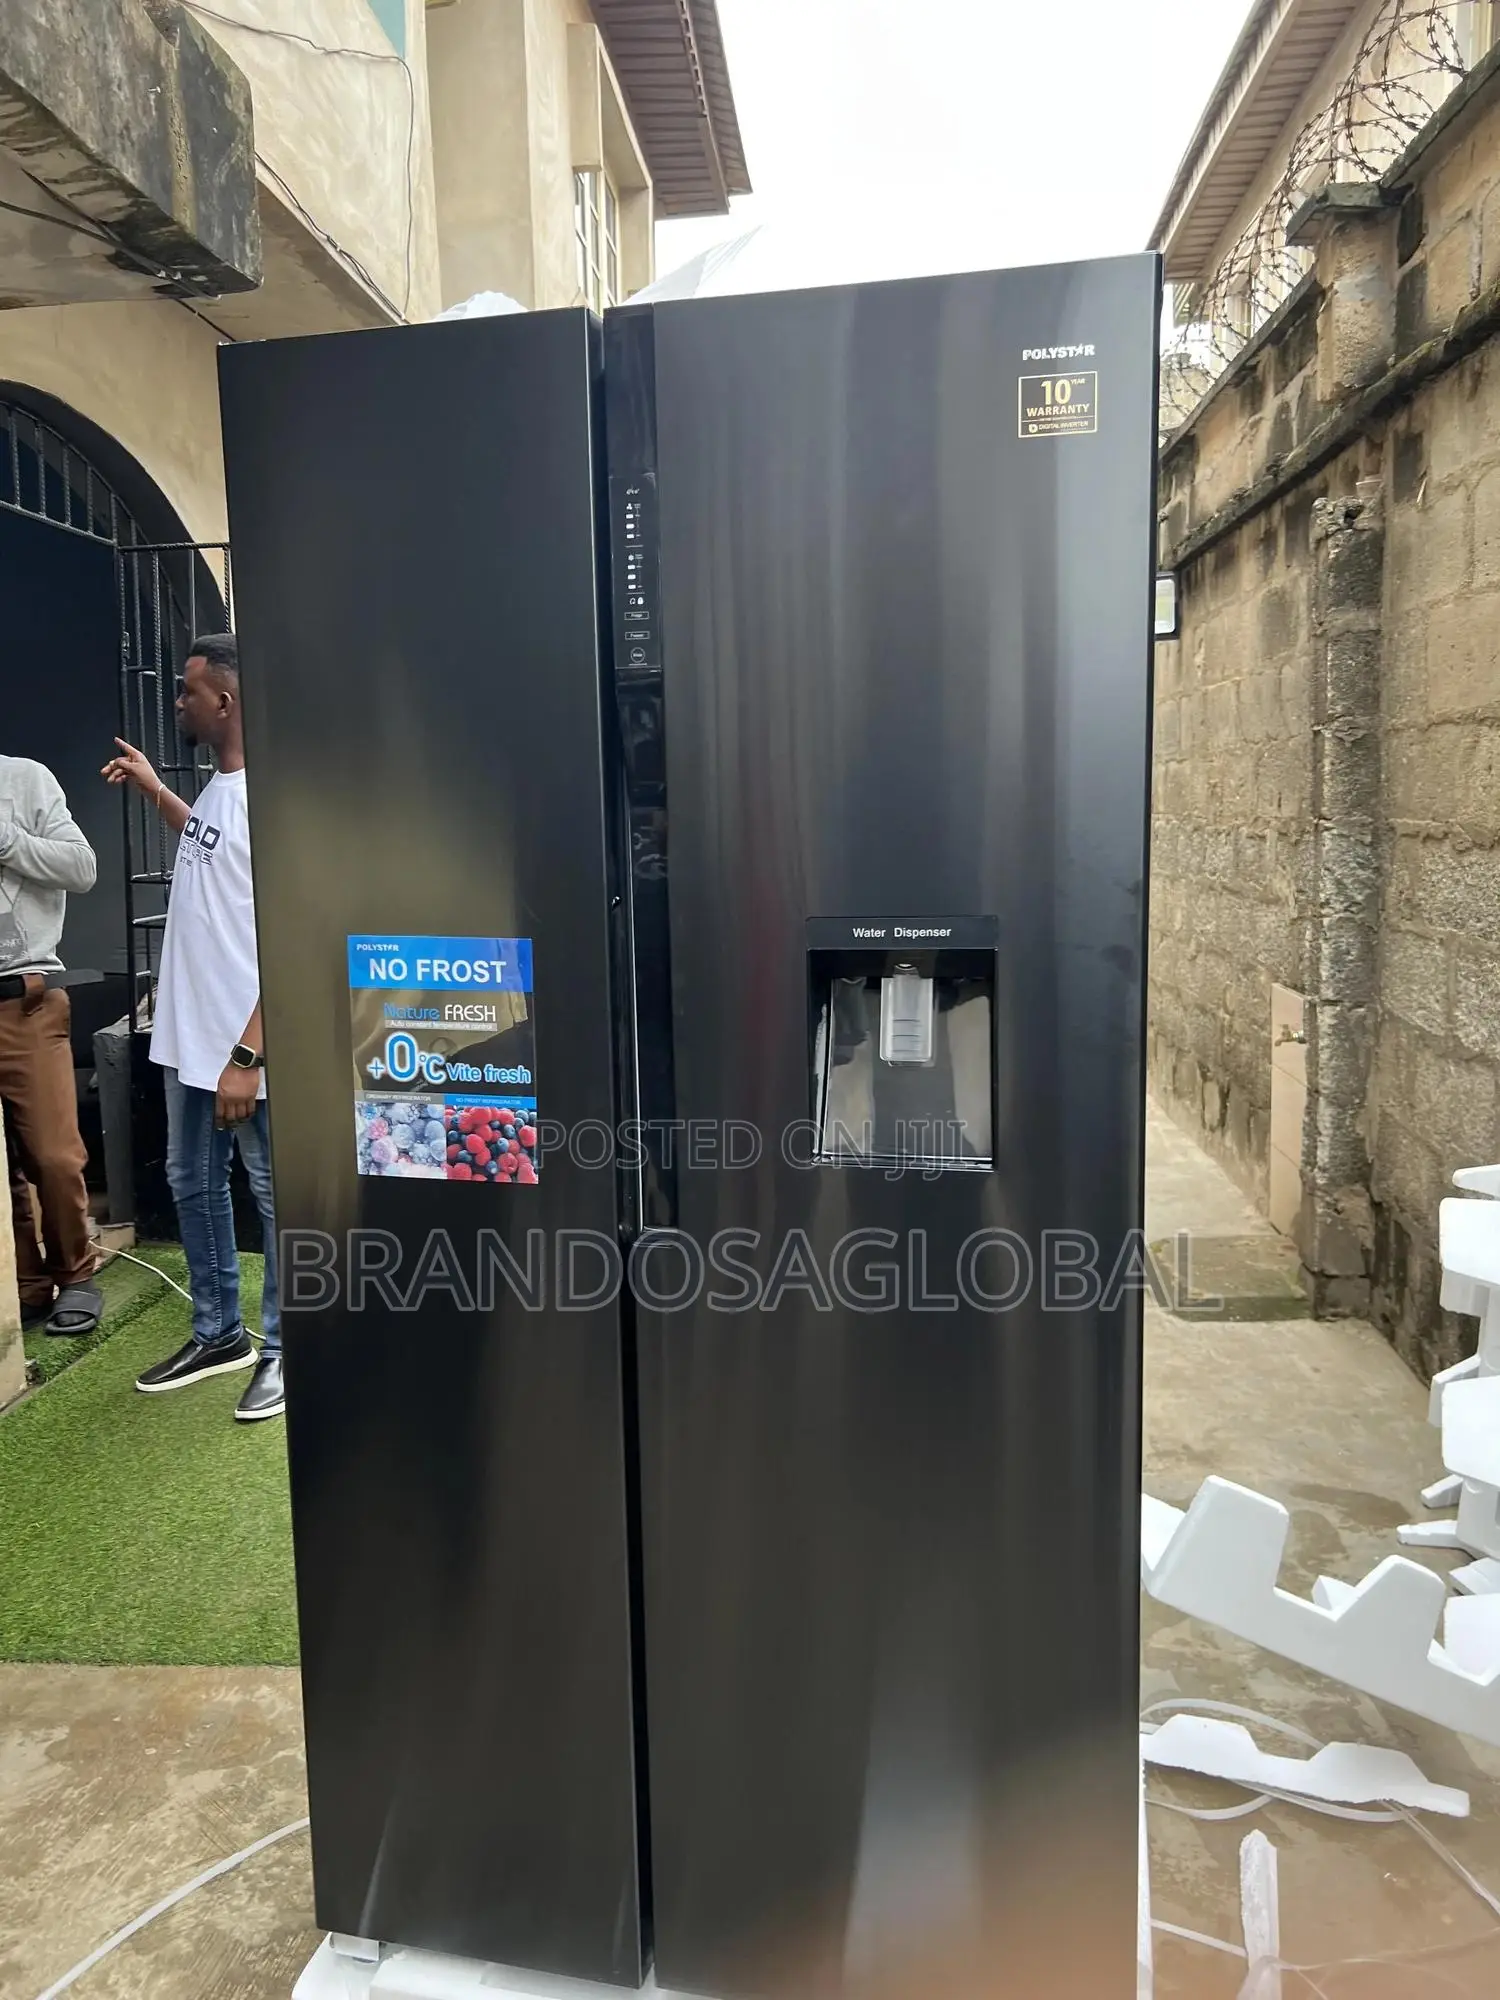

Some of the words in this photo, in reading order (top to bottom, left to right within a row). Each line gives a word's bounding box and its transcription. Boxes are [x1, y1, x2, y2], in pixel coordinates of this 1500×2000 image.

[1040, 379, 1072, 405] 10
[1026, 403, 1091, 417] WARRANTY
[183, 814, 221, 851] OLD
[853, 927, 886, 938] Water
[893, 926, 952, 939] Dispenser
[369, 958, 408, 981] NO
[416, 959, 507, 983] FROST
[383, 1002, 440, 1020] Nature
[444, 1004, 497, 1022] FRESH
[446, 1063, 482, 1083] Vite
[483, 1064, 532, 1084] fresh
